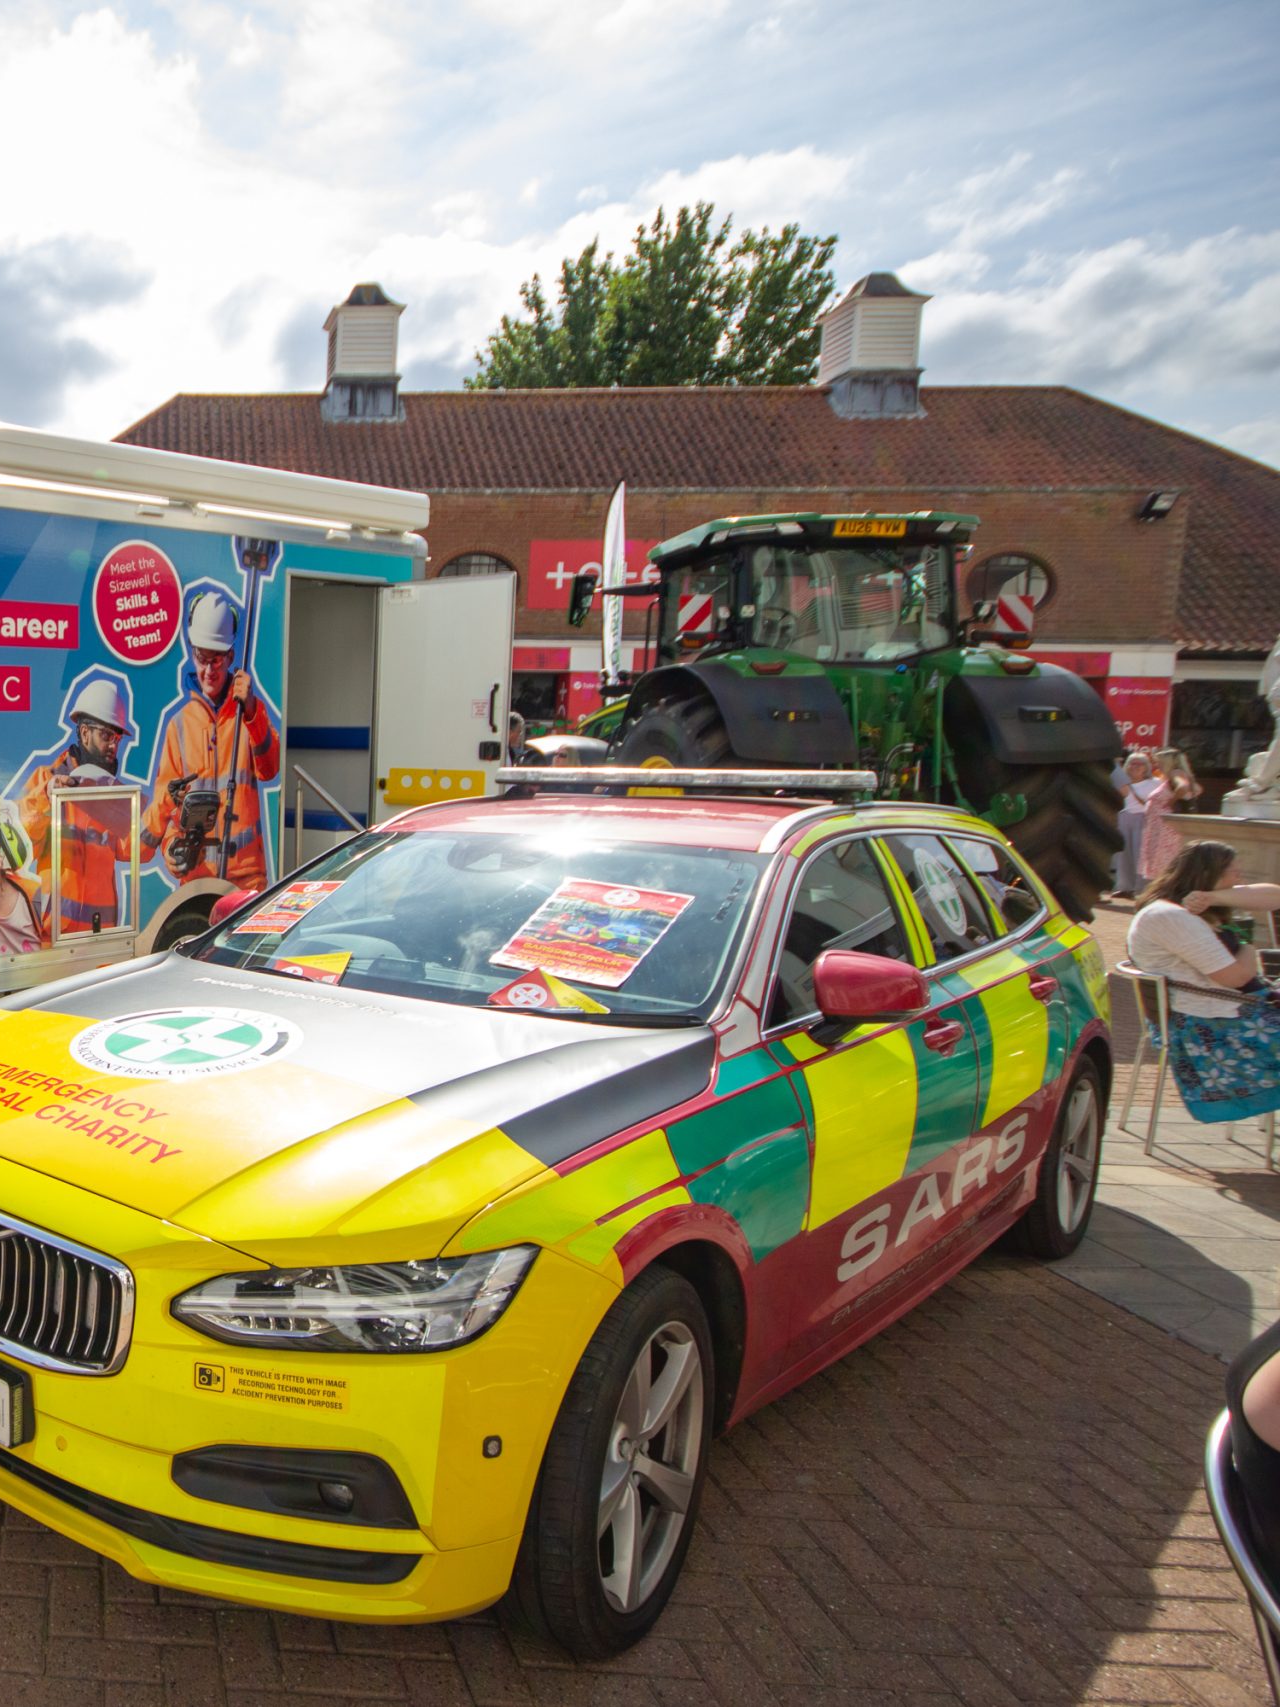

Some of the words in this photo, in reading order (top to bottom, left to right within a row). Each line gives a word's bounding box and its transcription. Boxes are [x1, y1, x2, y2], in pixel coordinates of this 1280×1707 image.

[110, 561, 134, 575] Meet
[137, 556, 155, 570] the
[109, 574, 148, 593] Sizewell
[151, 572, 161, 585] C
[116, 594, 147, 612] Skills
[150, 590, 159, 605] &
[112, 609, 168, 632] Outreach
[125, 628, 161, 648] Team!
[3, 676, 21, 702] C
[35, 1104, 184, 1164] CHARITY
[837, 1113, 1029, 1283] SARS
[229, 1366, 244, 1376] THIS
[246, 1369, 272, 1379] VEHICLE
[274, 1372, 280, 1381] IS
[282, 1373, 304, 1384] FITTED
[306, 1376, 323, 1386] WITH
[325, 1379, 347, 1389] IMAGE
[238, 1378, 275, 1391] RECORDING
[277, 1384, 320, 1398] TECHNOLOGY
[323, 1390, 336, 1398] FOR
[232, 1387, 263, 1400] ACCIDENT
[265, 1393, 305, 1405] PREVENTION
[308, 1399, 343, 1410] PURPOSES
